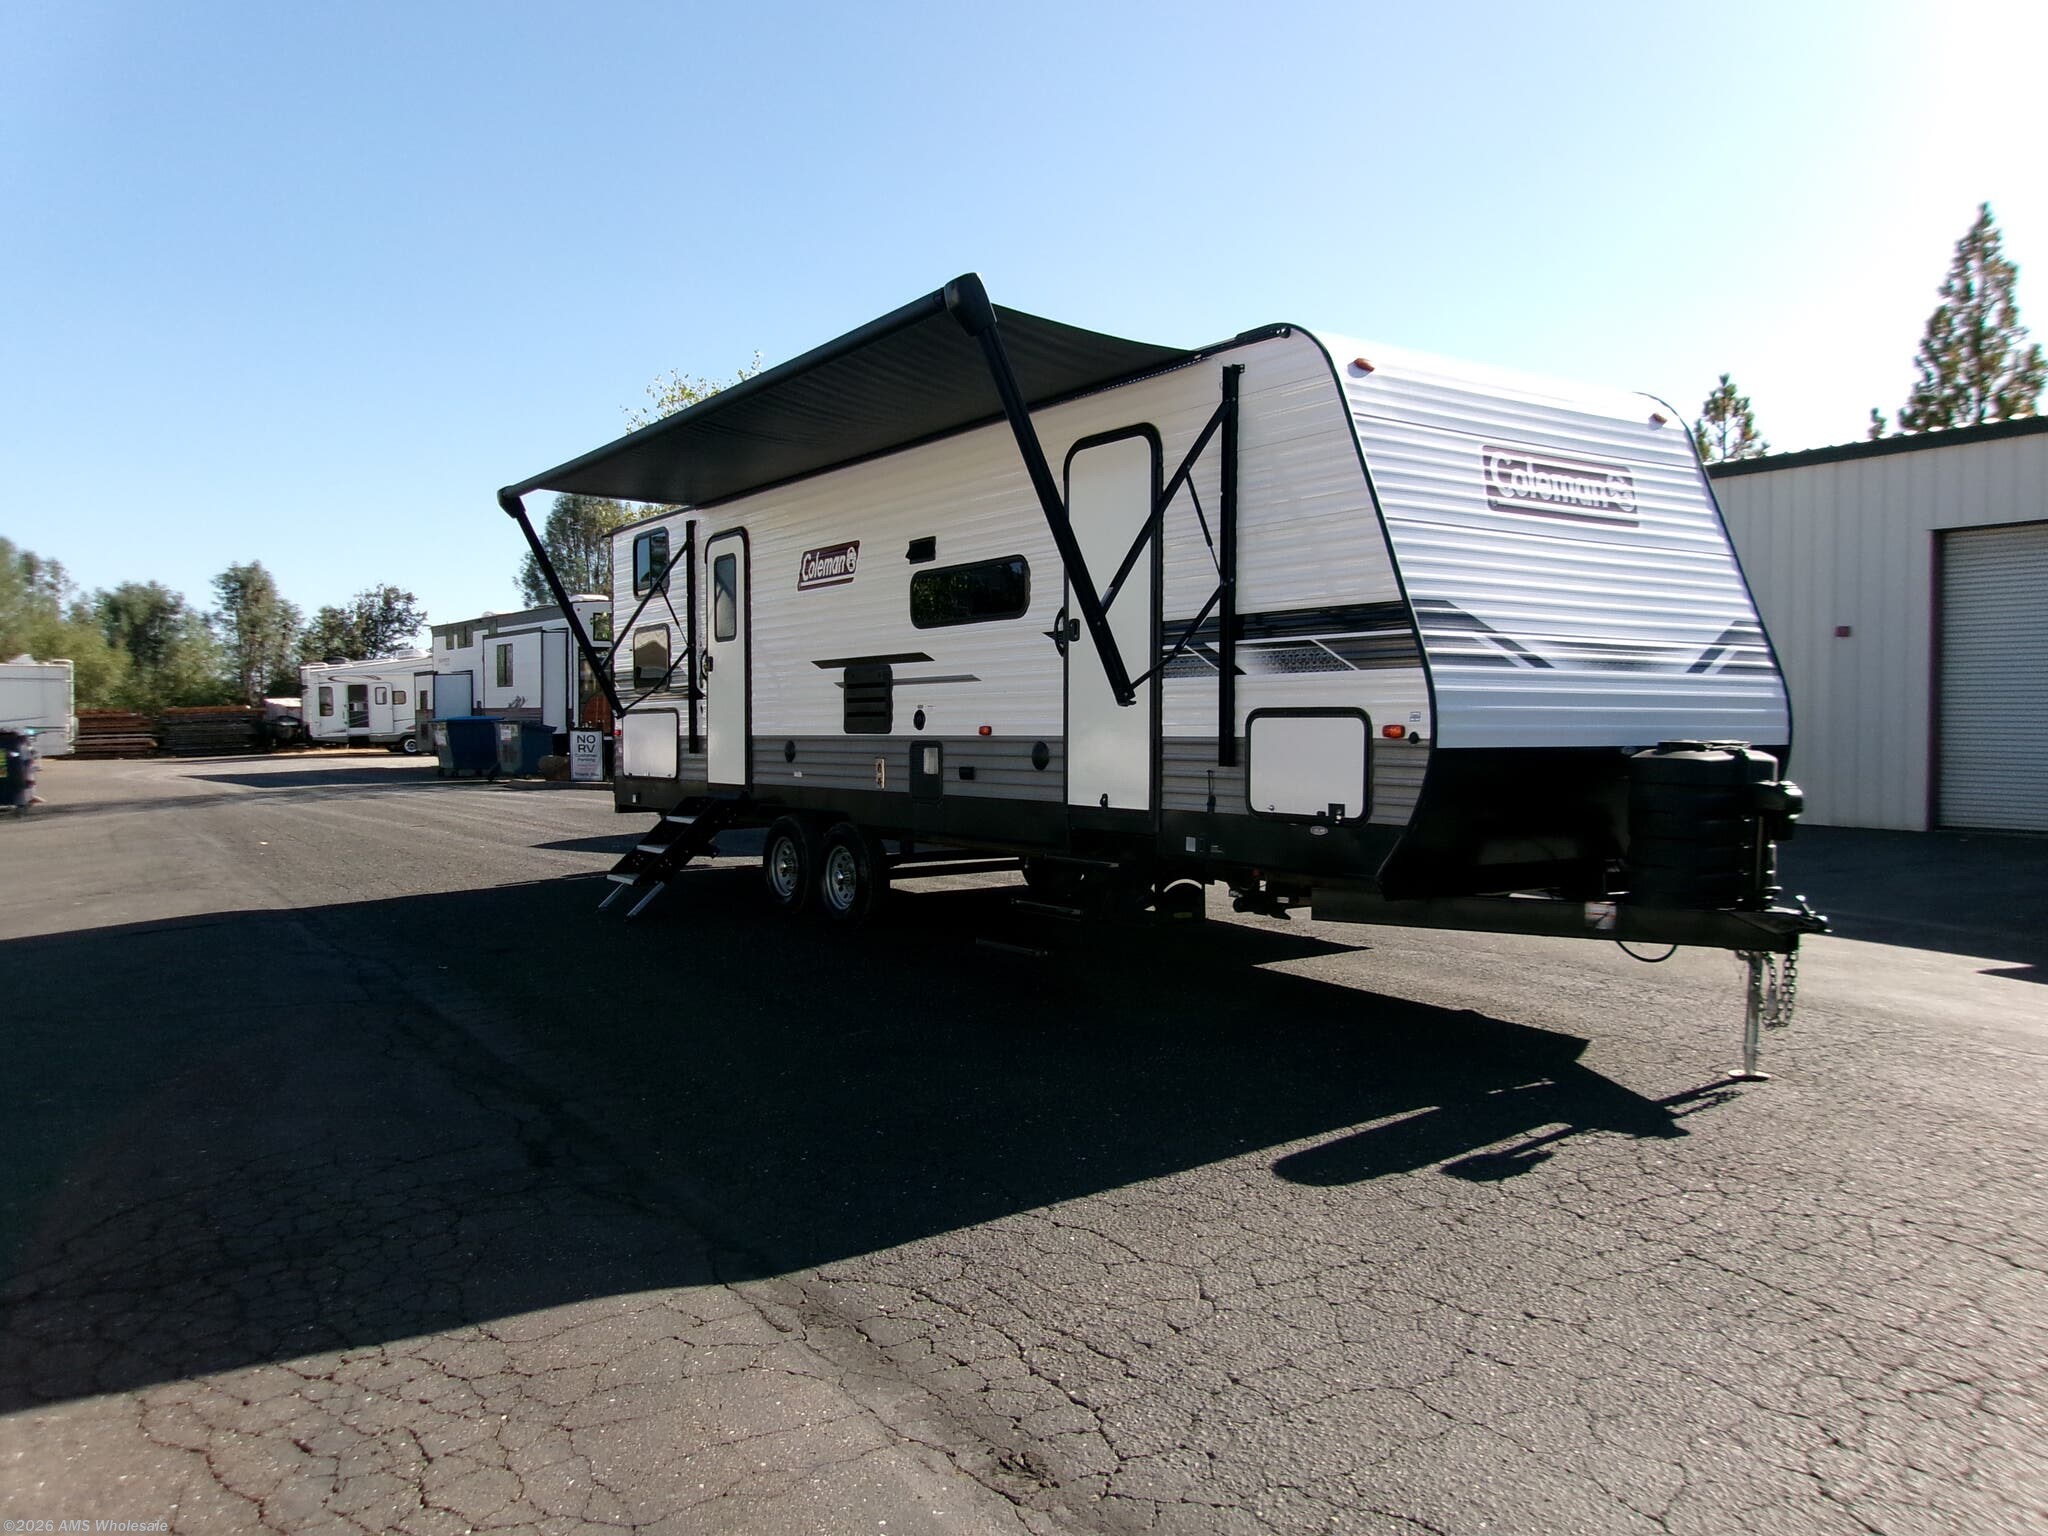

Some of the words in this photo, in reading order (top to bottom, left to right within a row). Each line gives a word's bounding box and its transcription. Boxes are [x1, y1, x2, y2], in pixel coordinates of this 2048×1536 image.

[1490, 451, 1609, 508] Coleman
[802, 551, 846, 581] Coleman
[576, 734, 596, 744] NO
[578, 744, 596, 753] RV
